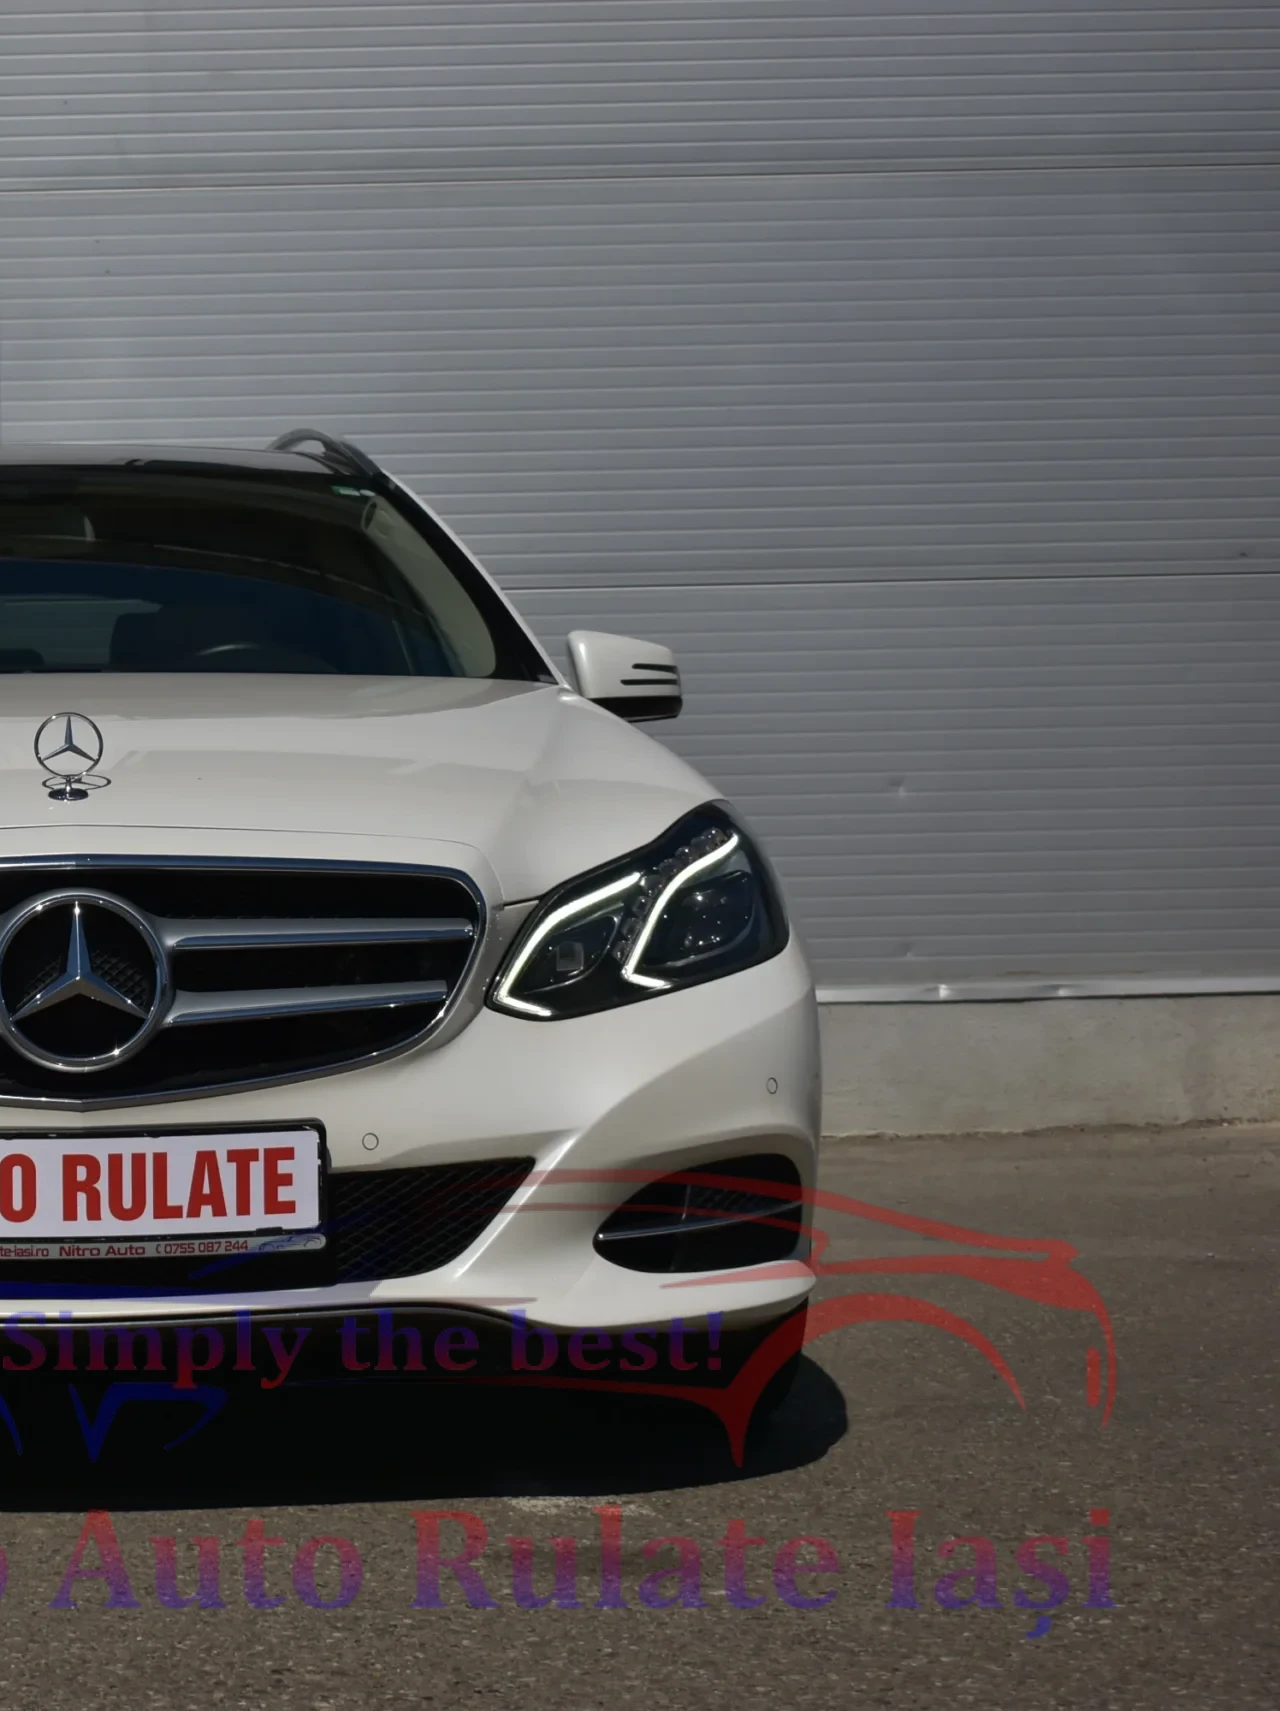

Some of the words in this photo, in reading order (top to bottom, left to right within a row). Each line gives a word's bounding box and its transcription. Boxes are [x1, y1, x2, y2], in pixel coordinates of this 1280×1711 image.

[62, 1147, 297, 1222] RULATE
[59, 1244, 101, 1257] Nitro
[104, 1244, 146, 1257] Auto
[164, 1243, 195, 1255] 0755
[198, 1242, 221, 1254] 087
[224, 1240, 249, 1252] 244
